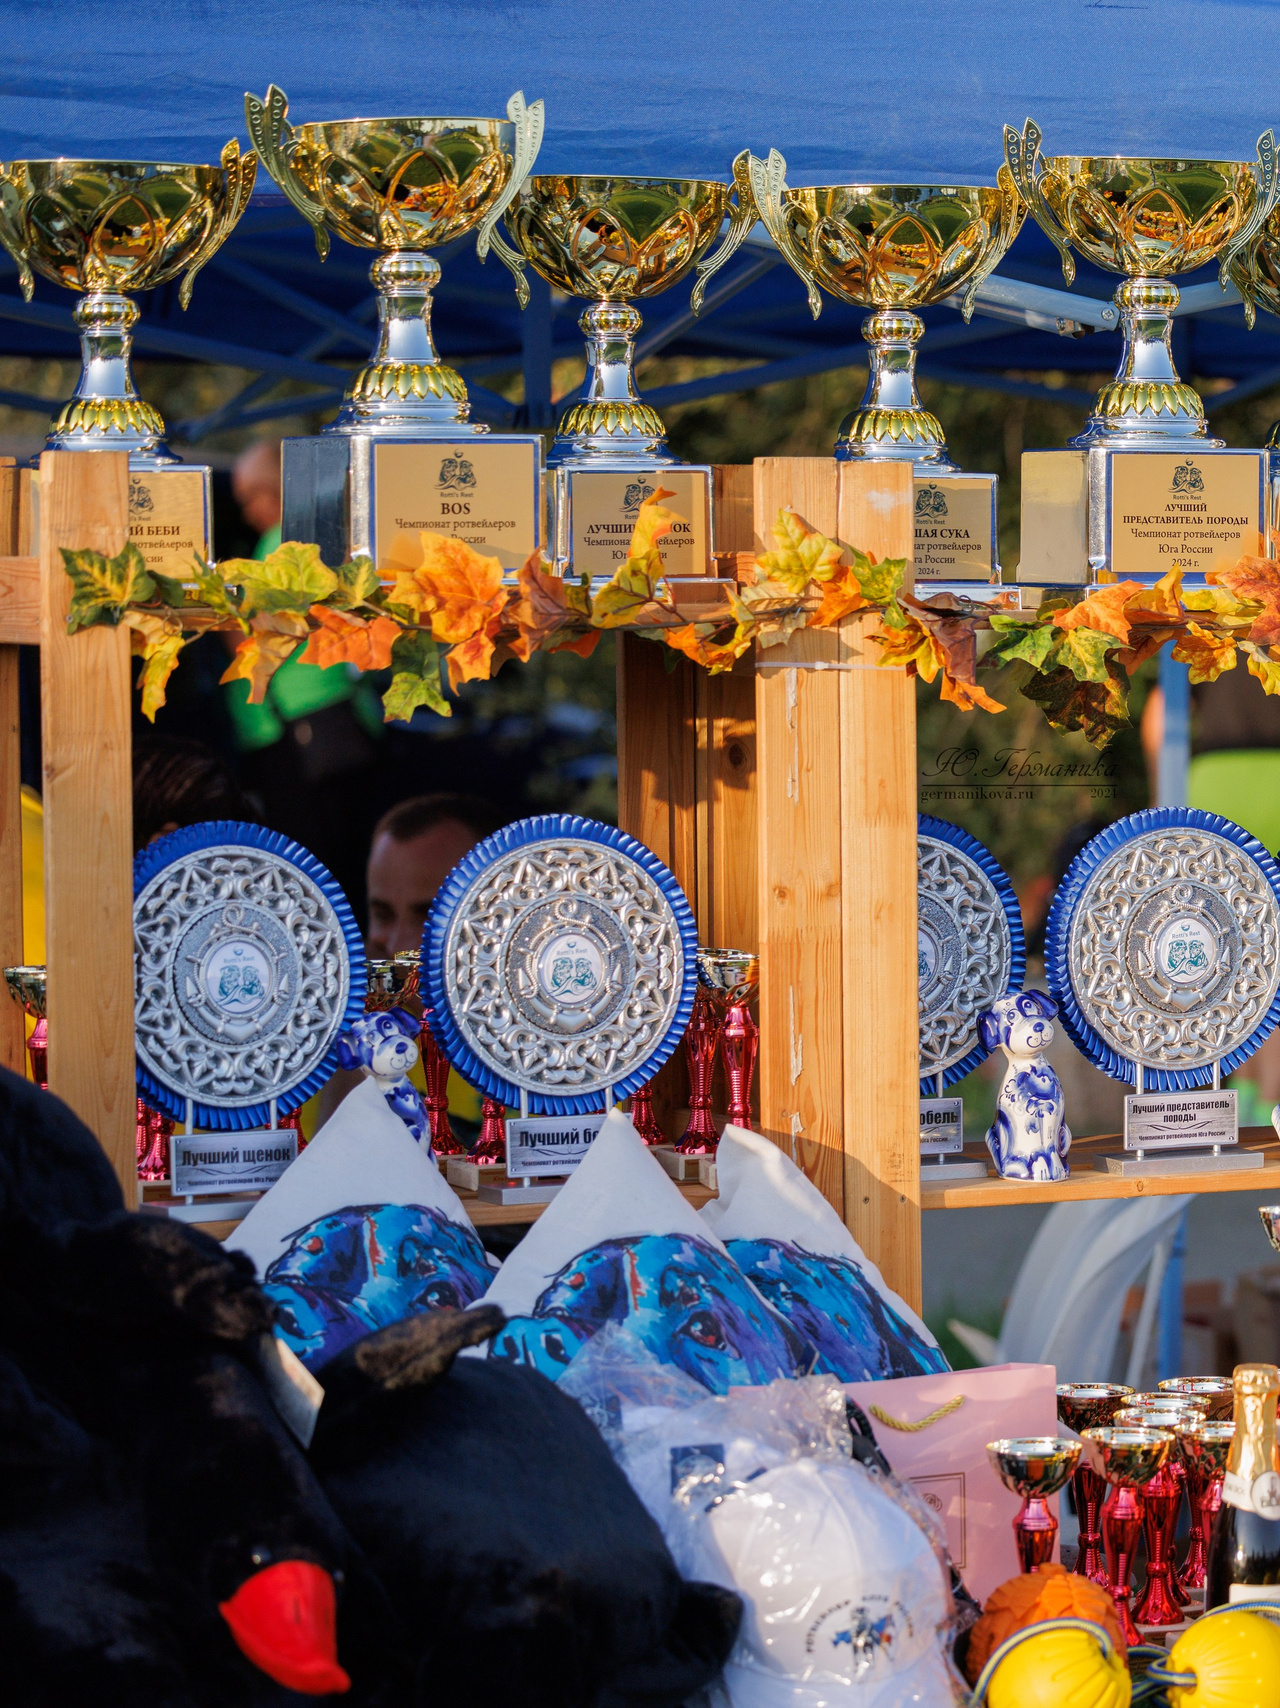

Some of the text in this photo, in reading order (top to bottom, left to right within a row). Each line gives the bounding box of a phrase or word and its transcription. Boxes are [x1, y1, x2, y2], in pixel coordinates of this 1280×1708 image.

[441, 502, 471, 515] BOS
[1164, 502, 1207, 512] ЛУЧШИЙ
[395, 518, 516, 531] Чемпионат ротвейлеров
[1123, 515, 1249, 526] ПРЕДСТАВИТЕЛЬ ПОРОДЫ
[147, 525, 180, 536] БЕБИ
[914, 528, 970, 539] ШАЯ СУКА
[1131, 529, 1241, 541] Чемпионат ротвейлеров
[583, 537, 695, 548] Чемпиона ейлеров
[927, 542, 982, 553] ротвейлеров
[1158, 544, 1213, 554] Юга России
[925, 555, 956, 564] России
[1171, 558, 1192, 567] 2024
[917, 567, 934, 575] 2024
[1132, 1099, 1230, 1114] Лучший представитель
[919, 1110, 958, 1126] обель
[1163, 1113, 1197, 1123] породы
[519, 1127, 580, 1148] Лучший
[182, 1146, 291, 1167] Лучший щенок
